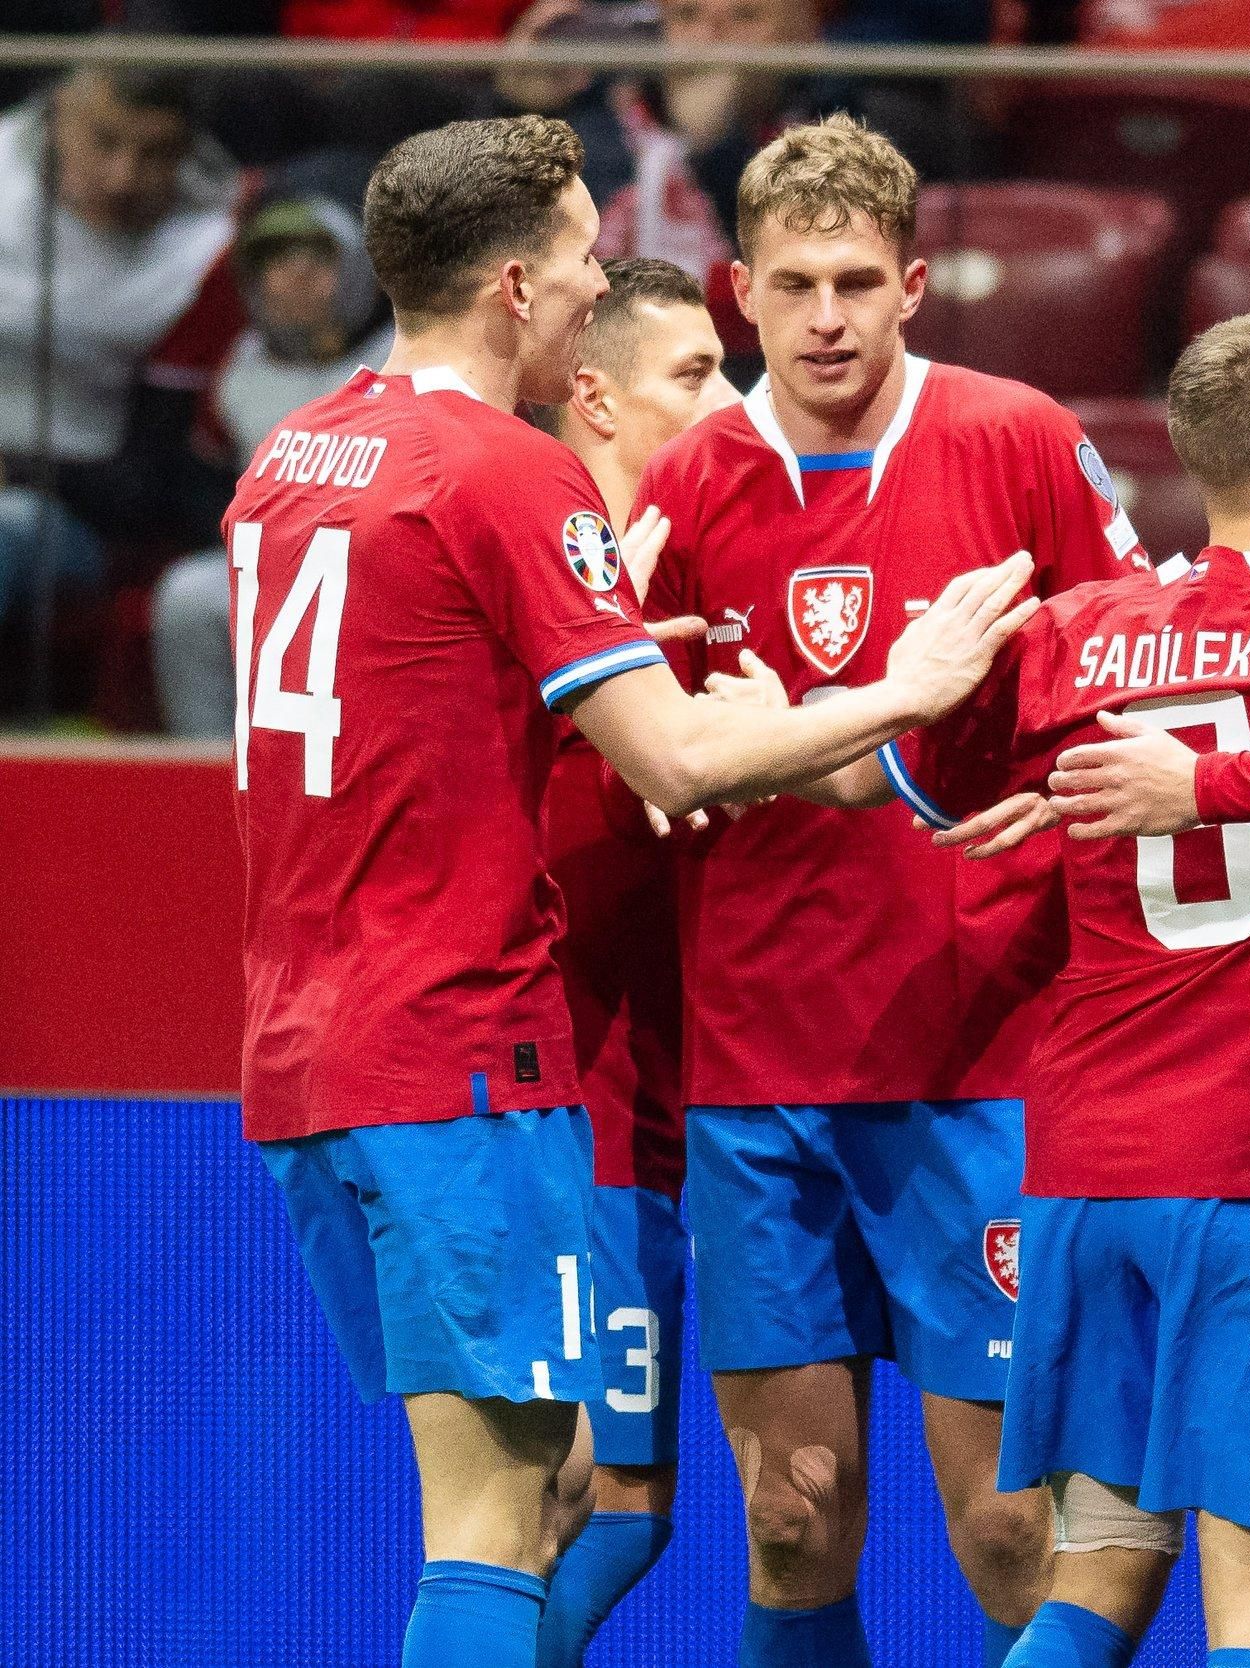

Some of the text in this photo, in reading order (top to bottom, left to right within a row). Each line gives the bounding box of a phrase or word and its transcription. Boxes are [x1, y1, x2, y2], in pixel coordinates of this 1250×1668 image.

[255, 430, 388, 489] PROVOD
[233, 521, 351, 798] 14
[606, 1307, 660, 1413] 3
